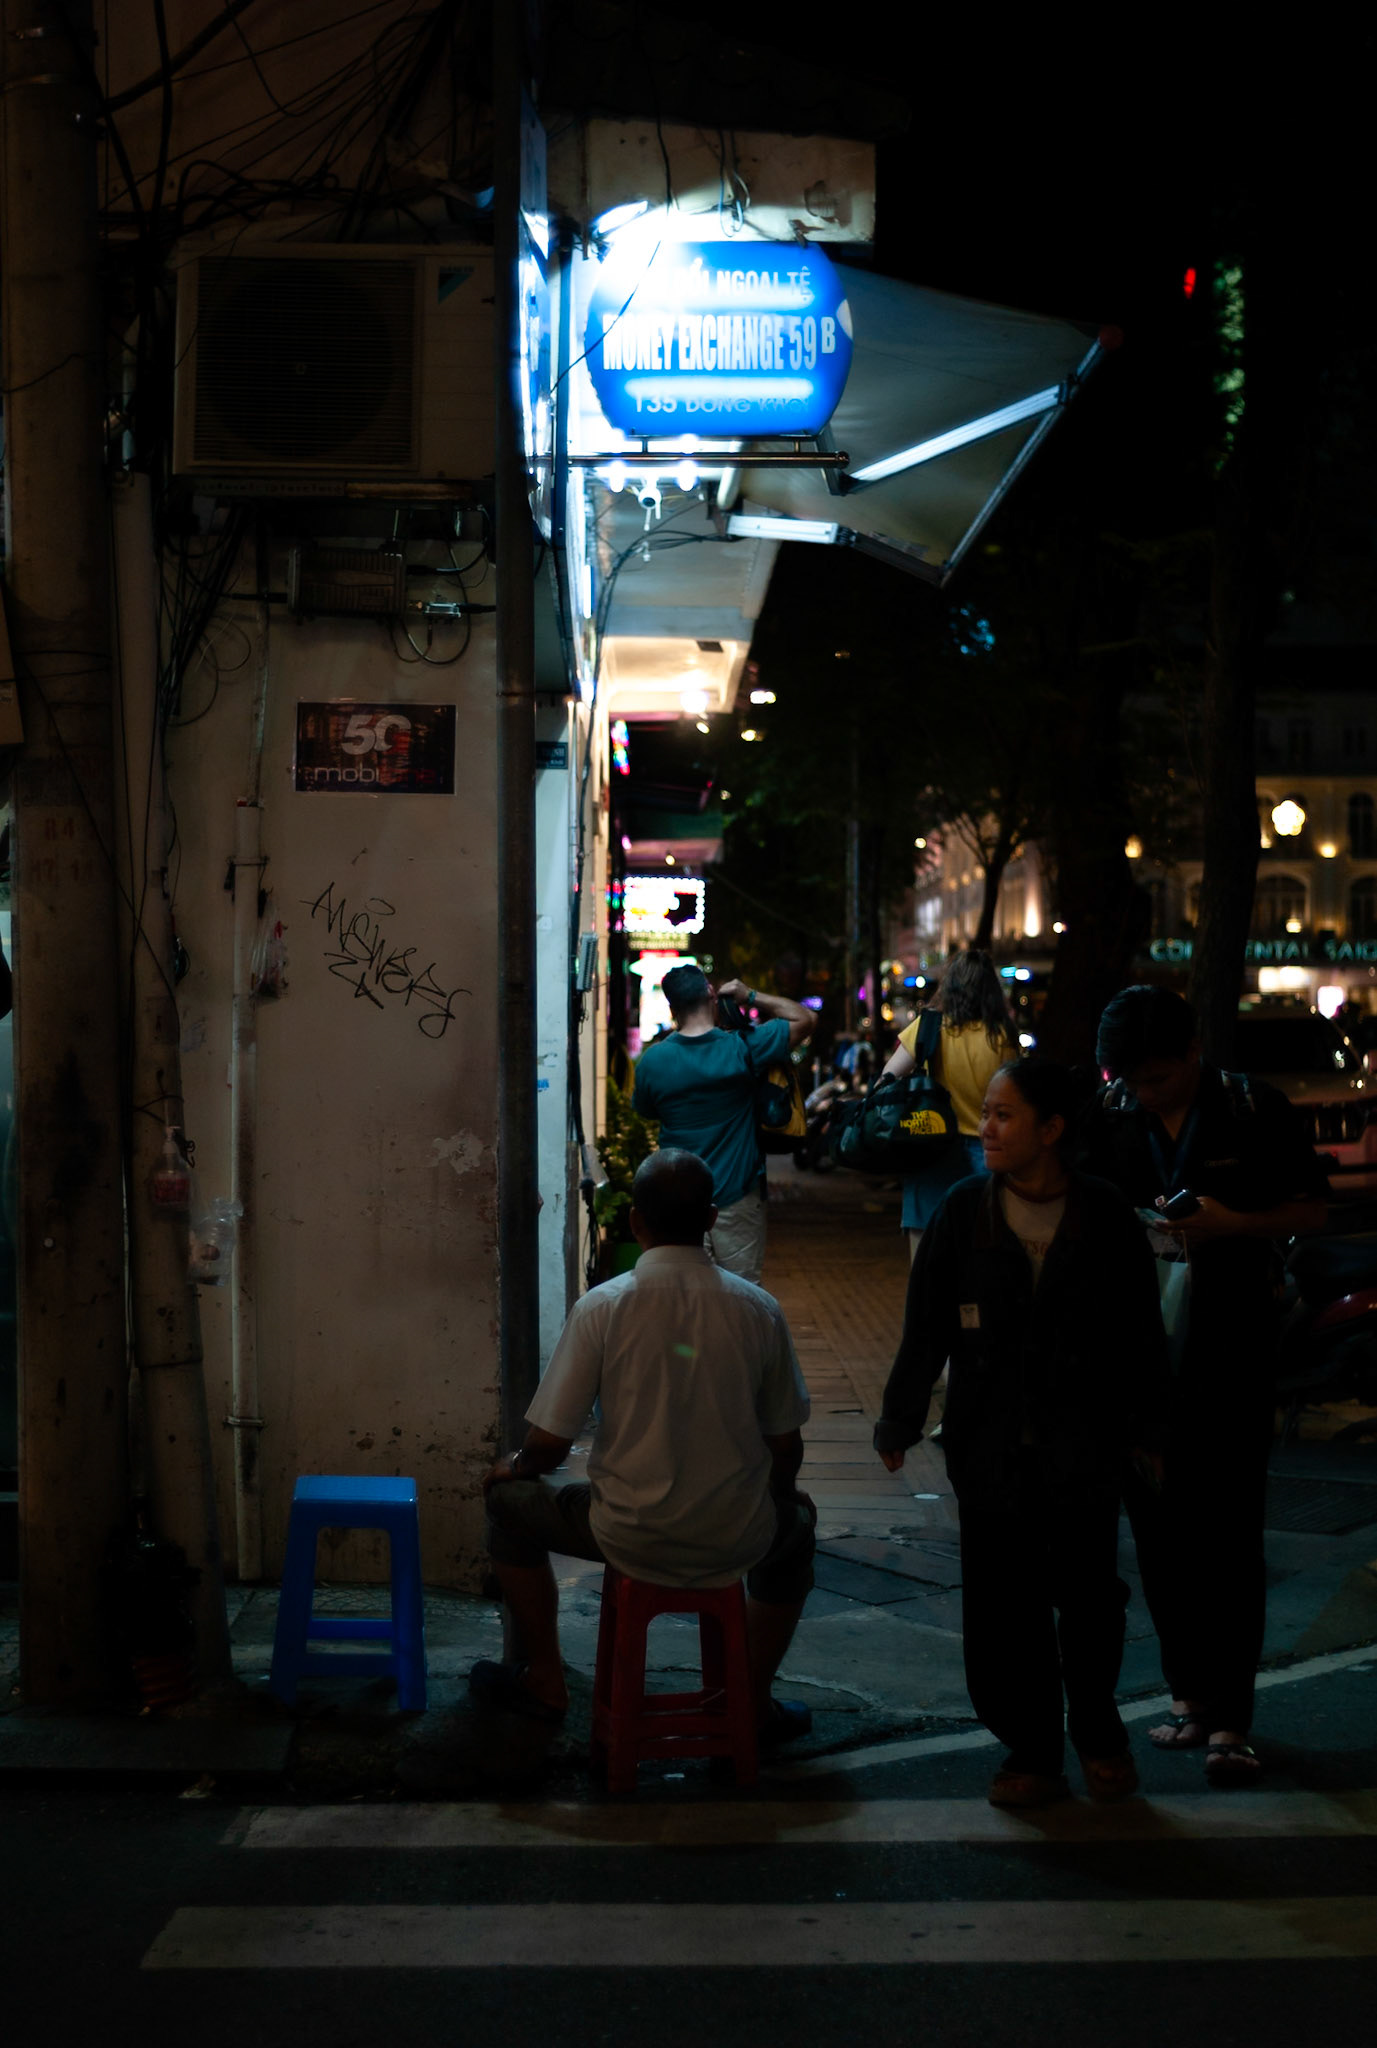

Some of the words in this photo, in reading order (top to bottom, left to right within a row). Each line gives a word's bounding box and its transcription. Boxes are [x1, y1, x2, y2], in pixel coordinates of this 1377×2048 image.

[602, 313, 674, 370] MONEY
[678, 314, 785, 370] EXCHANGE
[789, 316, 817, 370] 59
[820, 316, 836, 353] B
